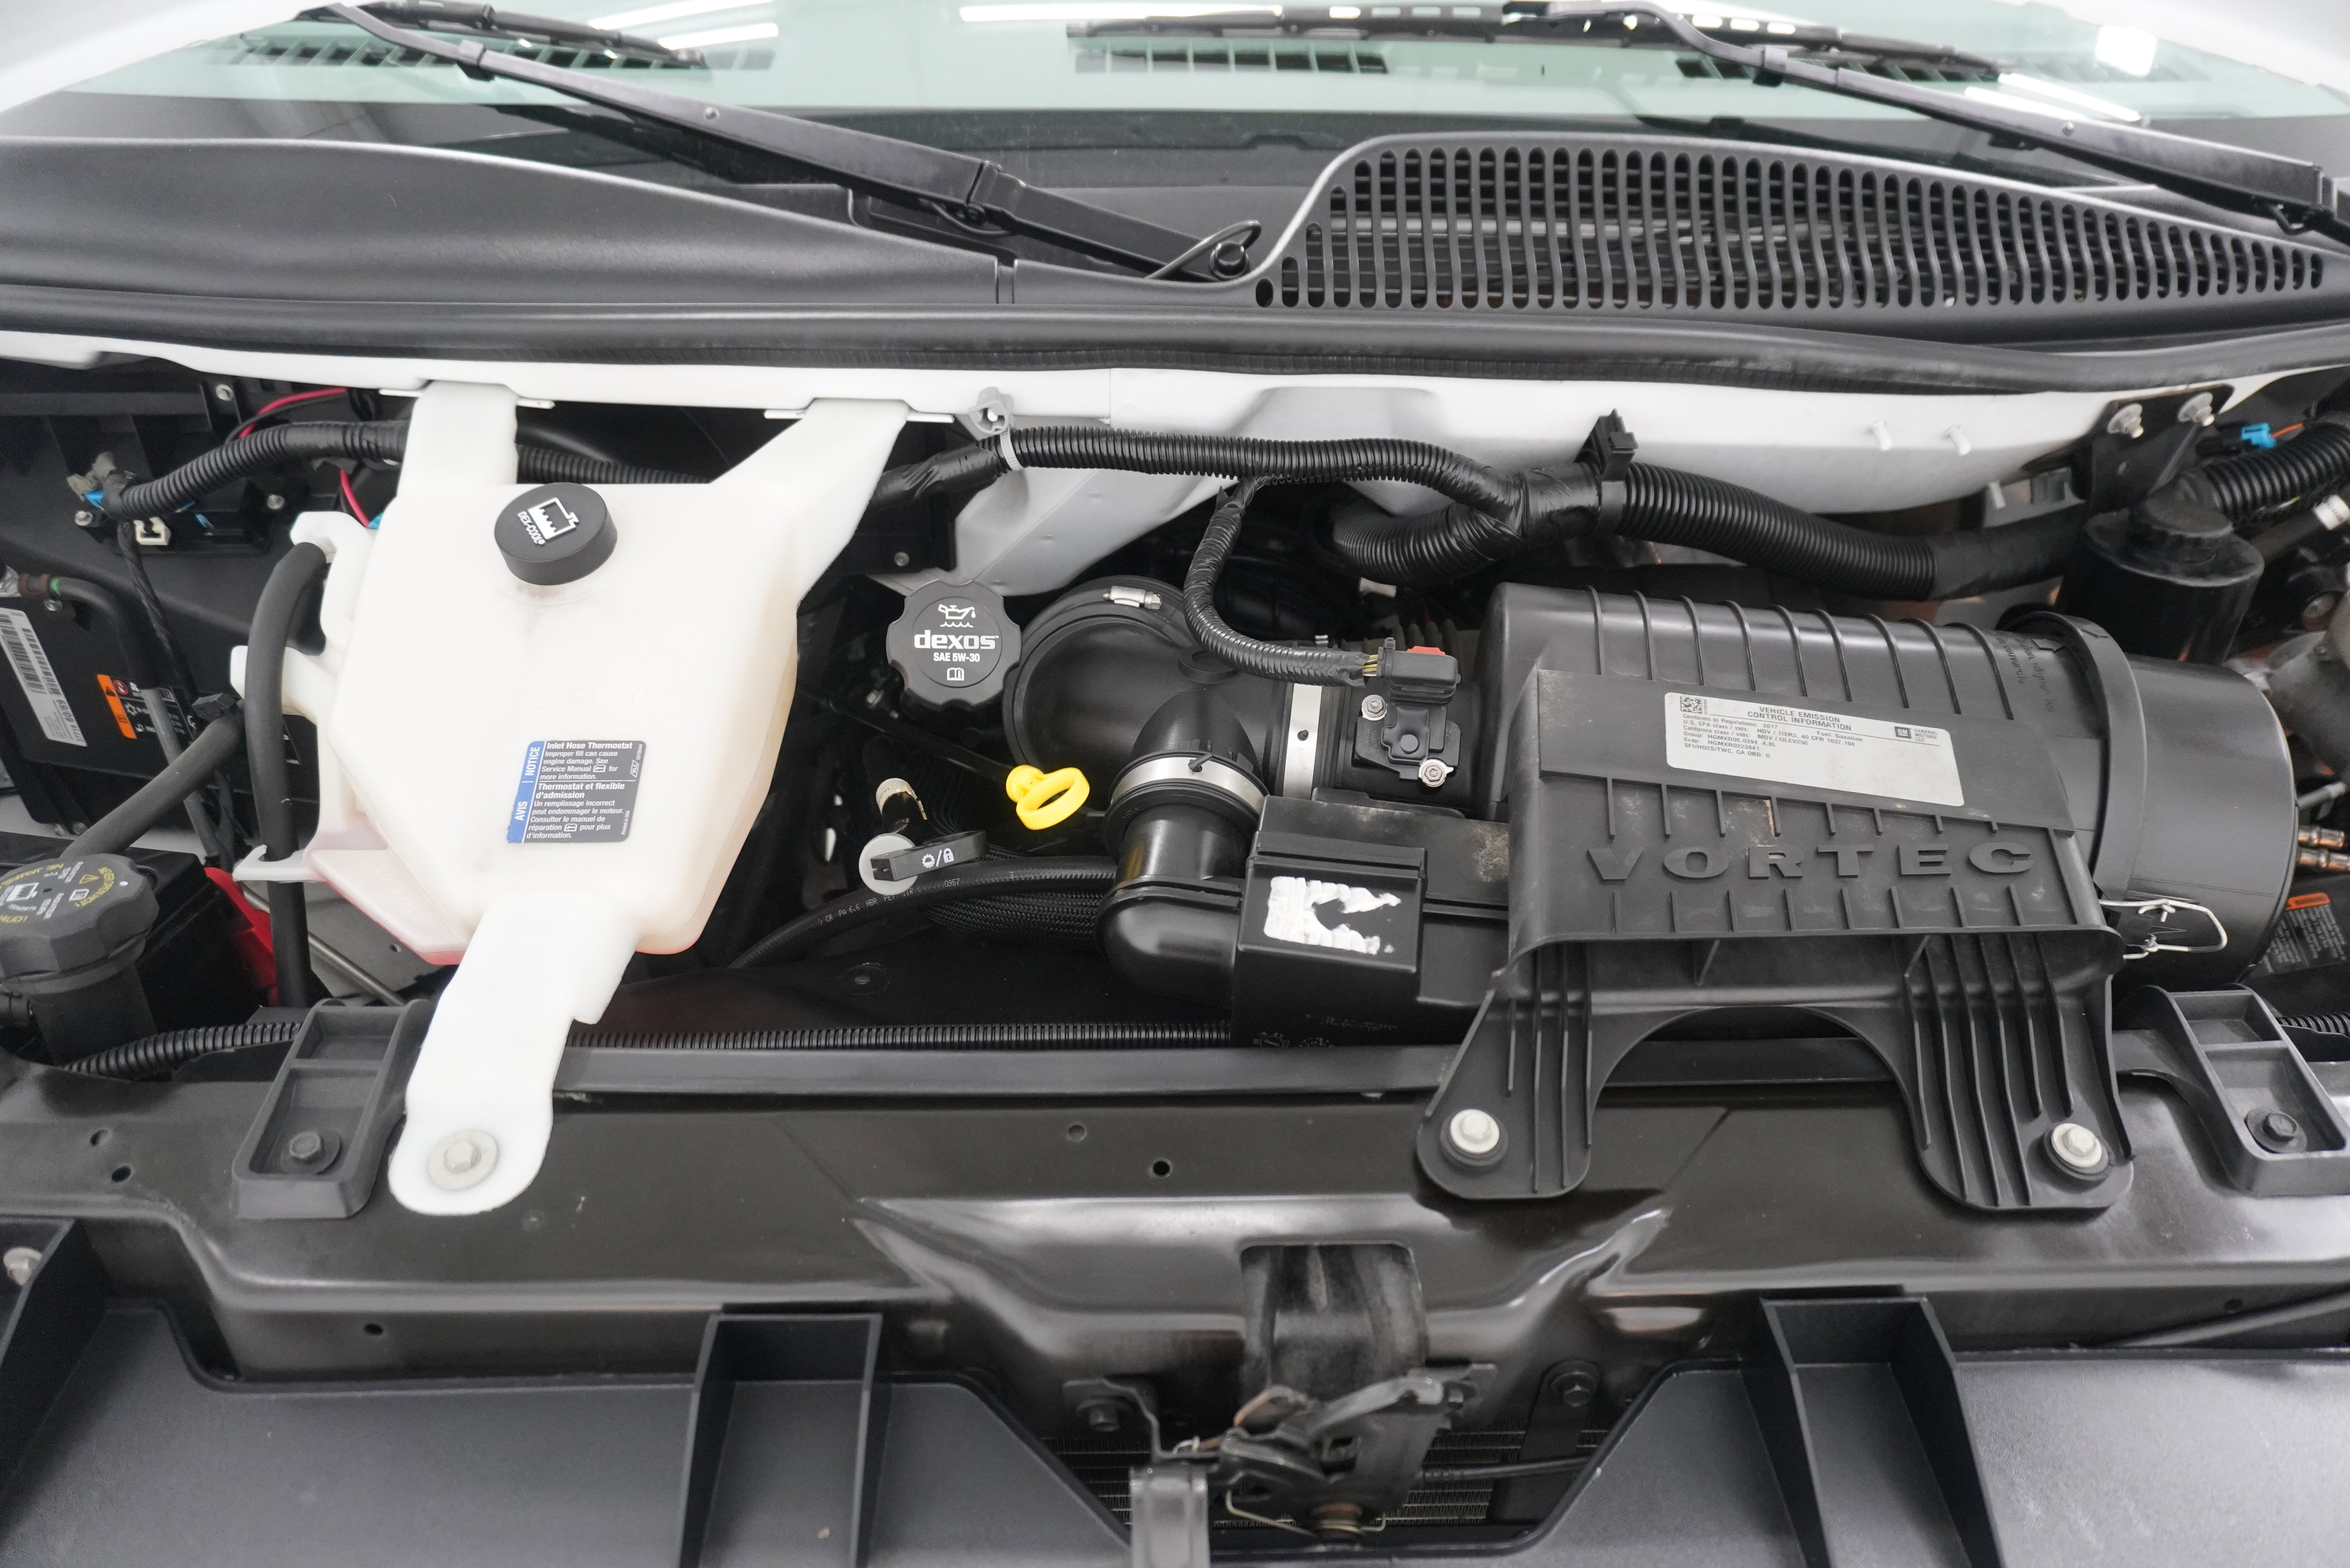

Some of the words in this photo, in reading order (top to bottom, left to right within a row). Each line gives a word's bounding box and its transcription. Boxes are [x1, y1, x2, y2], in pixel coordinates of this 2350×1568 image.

[914, 629, 996, 650] dexos
[933, 652, 950, 662] SAE
[953, 653, 980, 662] 5W-30
[1722, 719, 1758, 727] Regulations:
[1748, 711, 1788, 722] CONTROL
[1792, 717, 1851, 731] INFORMATION
[1759, 706, 1794, 716] VEHICLE
[1799, 712, 1840, 723] EMISSION
[1835, 734, 1863, 742] Gasoline
[525, 746, 540, 776] NOTICE
[515, 801, 528, 821] AVIS
[1586, 841, 2034, 881] VORTEC
[375, 865, 406, 895] COLD
[944, 878, 960, 888] 0957
[839, 908, 848, 917] PA
[849, 903, 860, 913] 6.6
[865, 897, 878, 907] NBR
